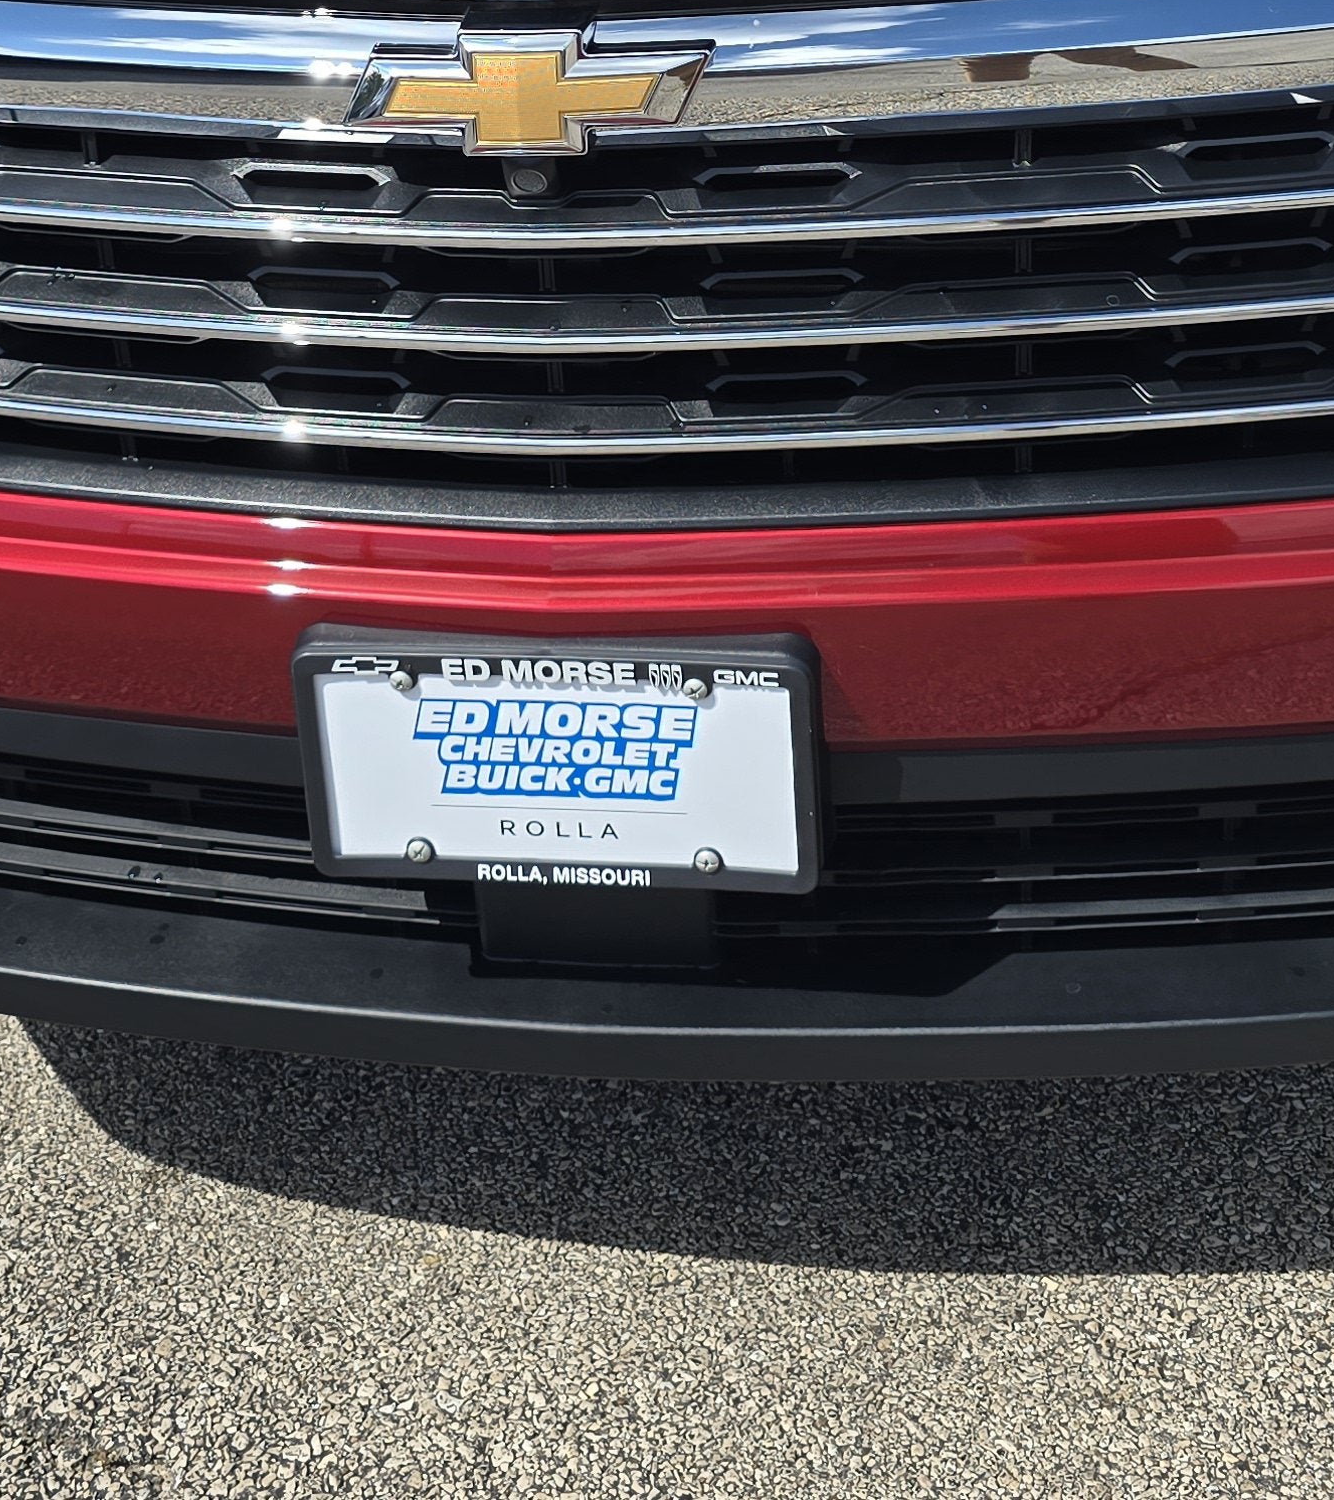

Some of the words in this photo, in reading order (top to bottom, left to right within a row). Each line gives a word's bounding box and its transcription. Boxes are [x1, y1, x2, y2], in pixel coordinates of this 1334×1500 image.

[441, 658, 491, 682] ED
[500, 659, 636, 686] MORSE
[713, 669, 780, 688] GMC
[416, 700, 490, 734] ED
[494, 702, 695, 741] MORSE
[499, 819, 619, 840] ROLLA
[477, 863, 548, 886] ROLLA,
[552, 865, 652, 887] MISSOURI
